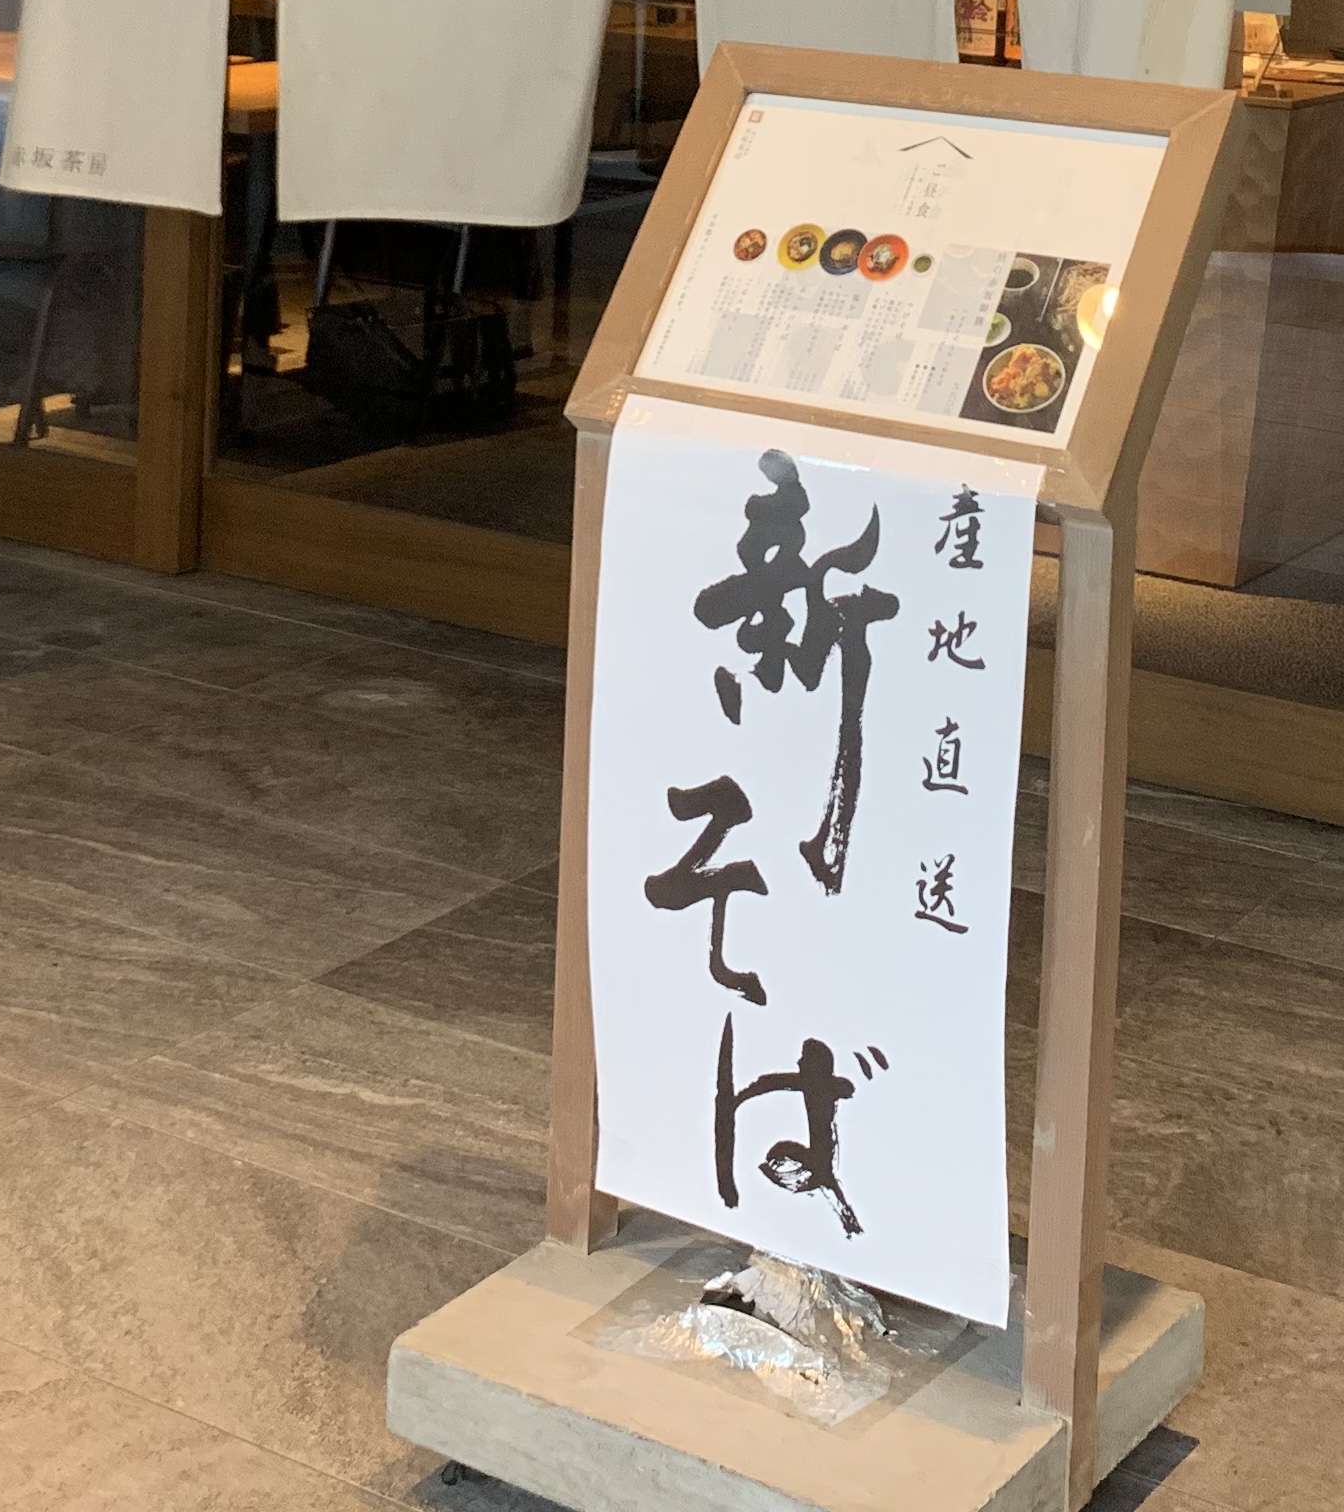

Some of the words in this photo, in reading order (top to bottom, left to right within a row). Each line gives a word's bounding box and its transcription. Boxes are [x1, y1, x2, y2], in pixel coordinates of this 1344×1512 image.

[644, 448, 900, 1240] 新そば
[914, 484, 986, 935] 産地直送
